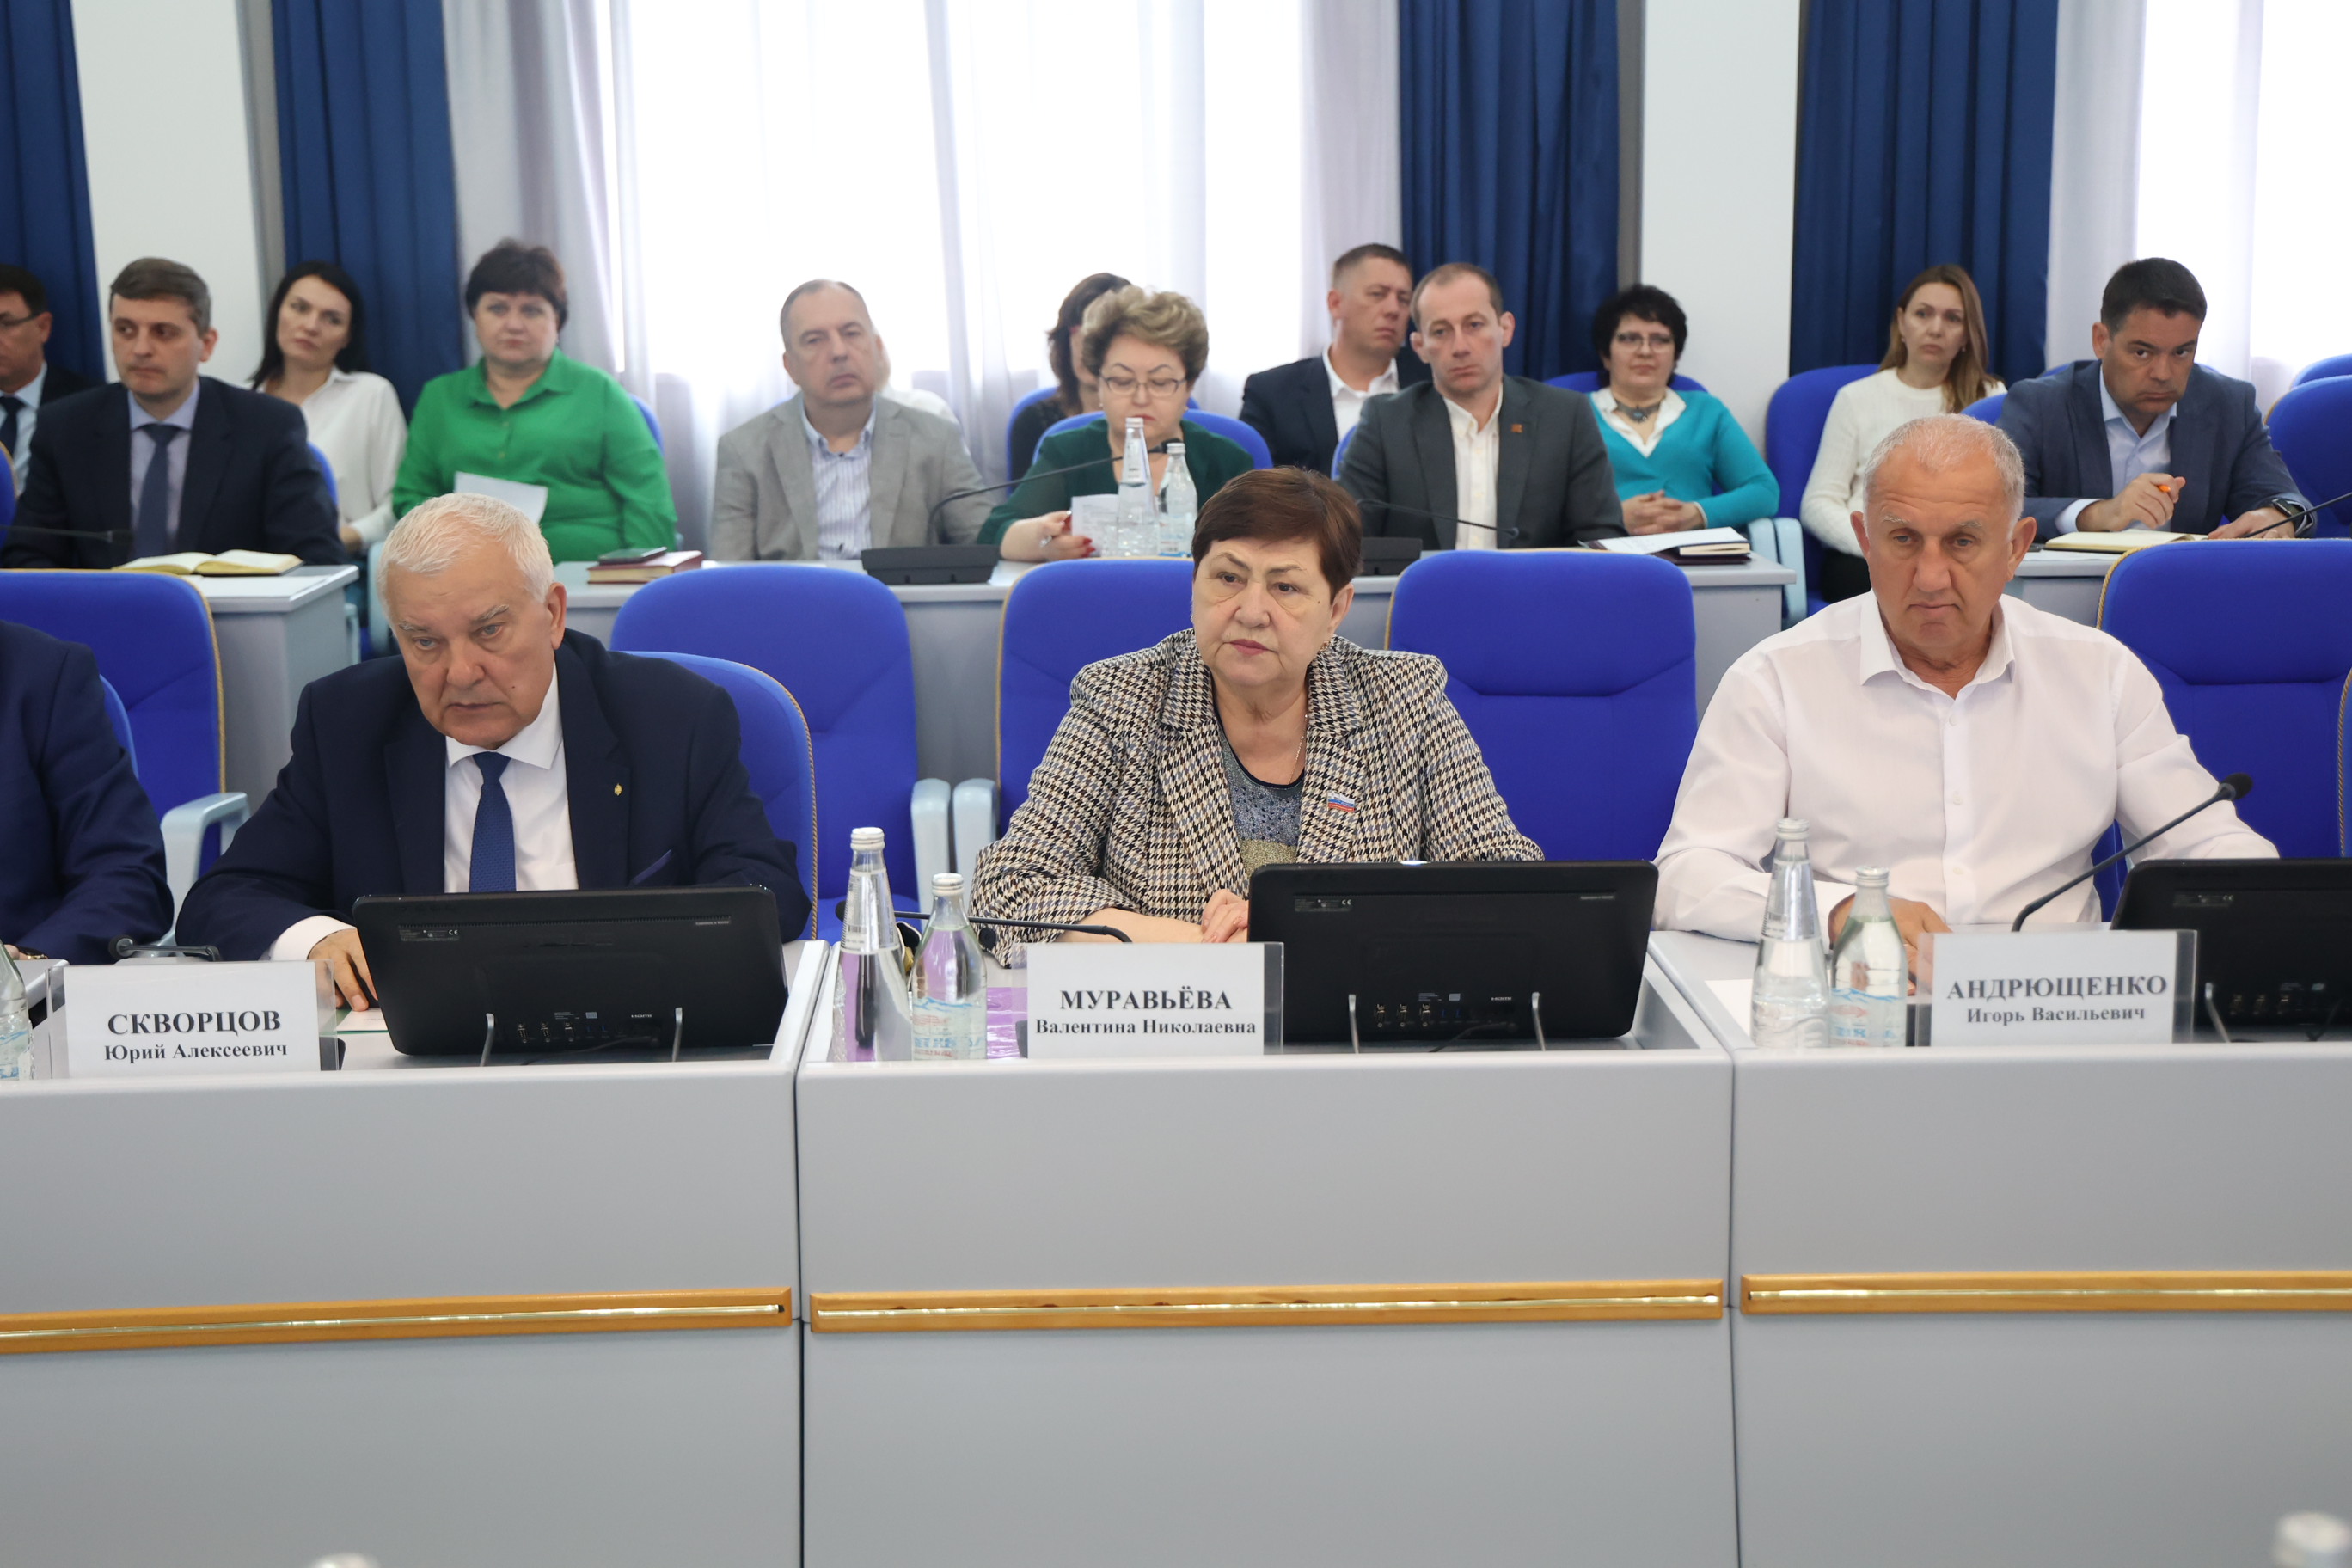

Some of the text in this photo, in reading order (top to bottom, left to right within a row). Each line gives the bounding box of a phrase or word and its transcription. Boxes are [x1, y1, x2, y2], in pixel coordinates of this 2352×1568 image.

[1060, 985, 1232, 1010] МУРАВЬЁВА
[1946, 975, 2167, 1001] АНДРЮЩЕНКО
[107, 1010, 281, 1036] СКВОРЦОВ
[1036, 1019, 1256, 1034] Валентина Николаевна
[1967, 1007, 2145, 1026] Игорь Васильевич
[105, 1044, 287, 1064] Юрий Алексеевич
